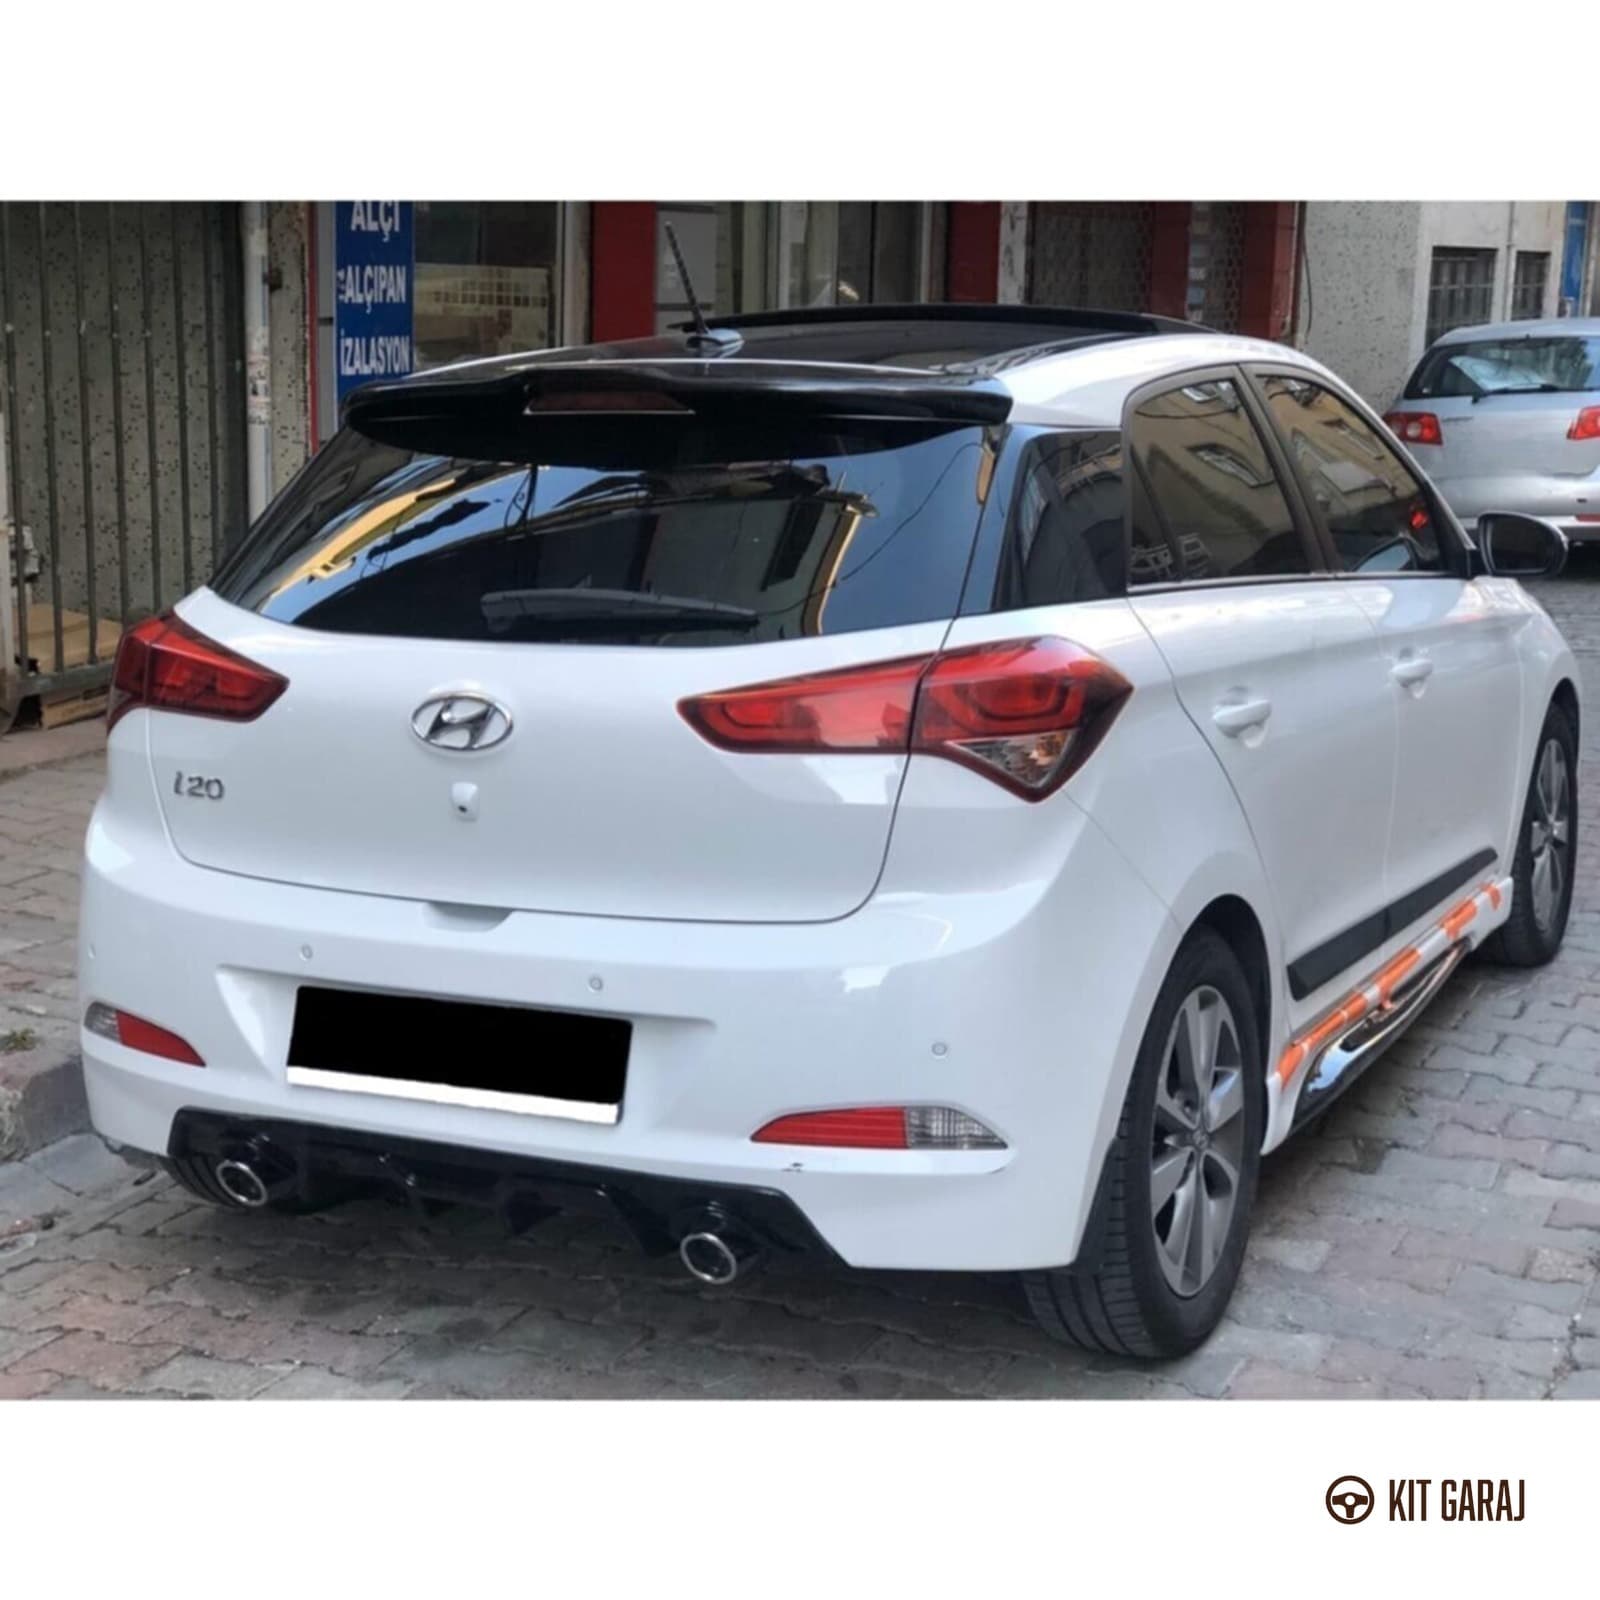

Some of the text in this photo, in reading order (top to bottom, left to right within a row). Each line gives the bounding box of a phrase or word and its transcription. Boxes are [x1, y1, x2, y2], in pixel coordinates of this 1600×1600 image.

[351, 200, 400, 242] ALÇI
[344, 265, 406, 314] ALÇIPAN
[340, 328, 411, 376] İZALASYON
